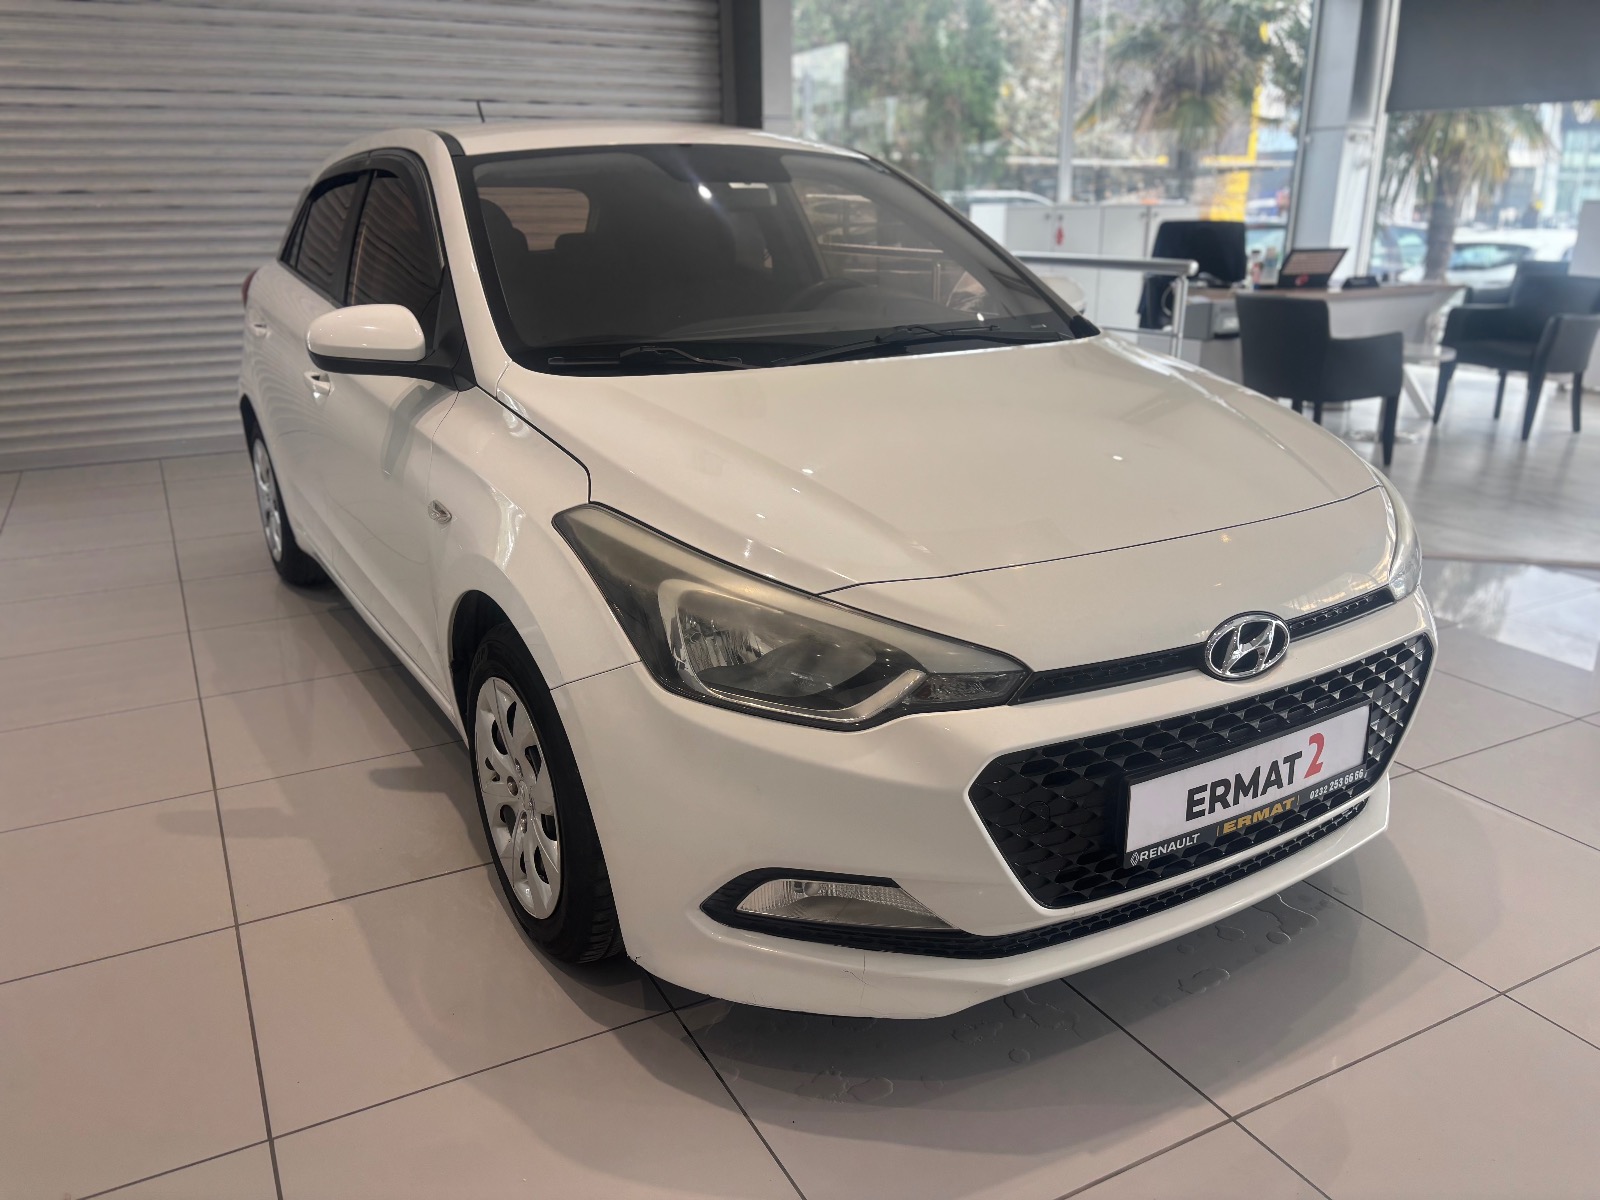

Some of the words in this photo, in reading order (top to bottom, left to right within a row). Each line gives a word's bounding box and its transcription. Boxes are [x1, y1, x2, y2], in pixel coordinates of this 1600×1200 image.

[1185, 751, 1303, 822] ERMAT
[1303, 732, 1325, 779] 2
[1310, 785, 1328, 800] 0232
[1329, 778, 1344, 792] 253
[1222, 797, 1295, 835] ERMAT
[1139, 833, 1200, 862] RENAULT
